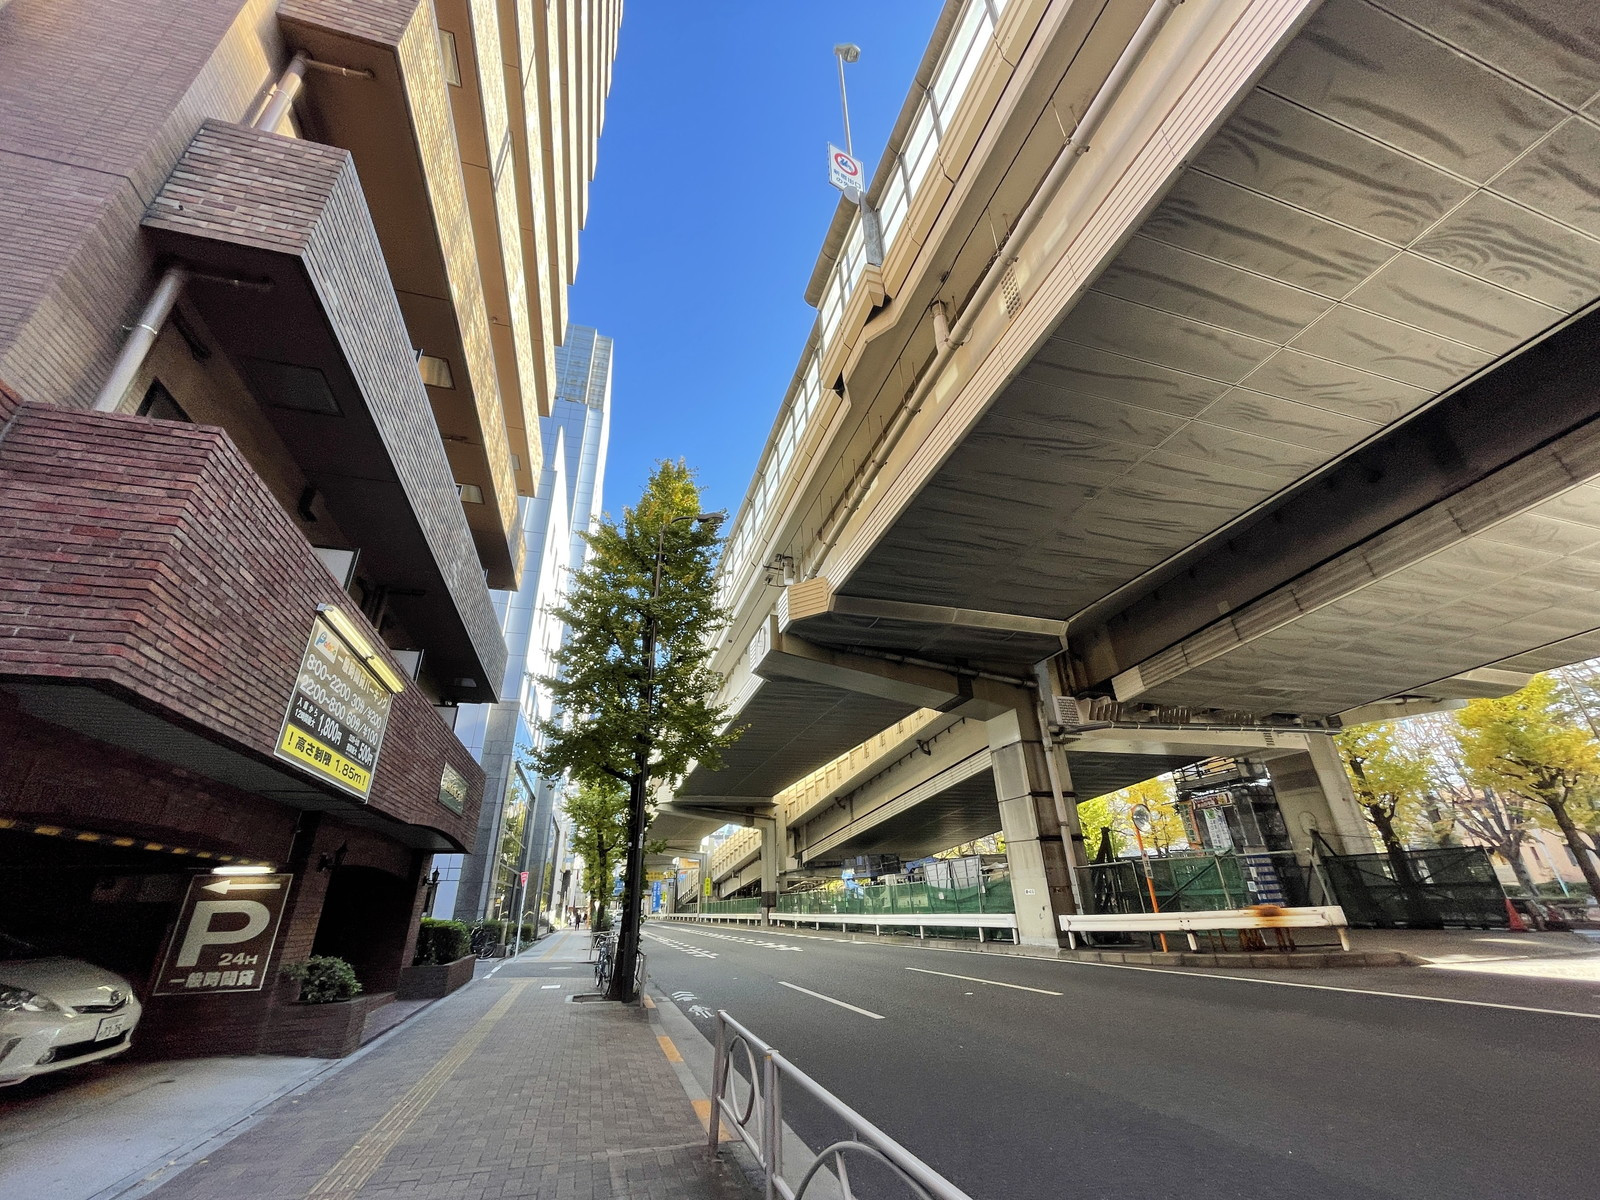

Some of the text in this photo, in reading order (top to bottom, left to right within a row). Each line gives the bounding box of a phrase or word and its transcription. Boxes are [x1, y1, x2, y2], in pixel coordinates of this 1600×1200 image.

[317, 713, 342, 746] 1,800円
[176, 900, 270, 968] P
[218, 952, 258, 966] 24H
[169, 969, 255, 988] 一般時間貸
